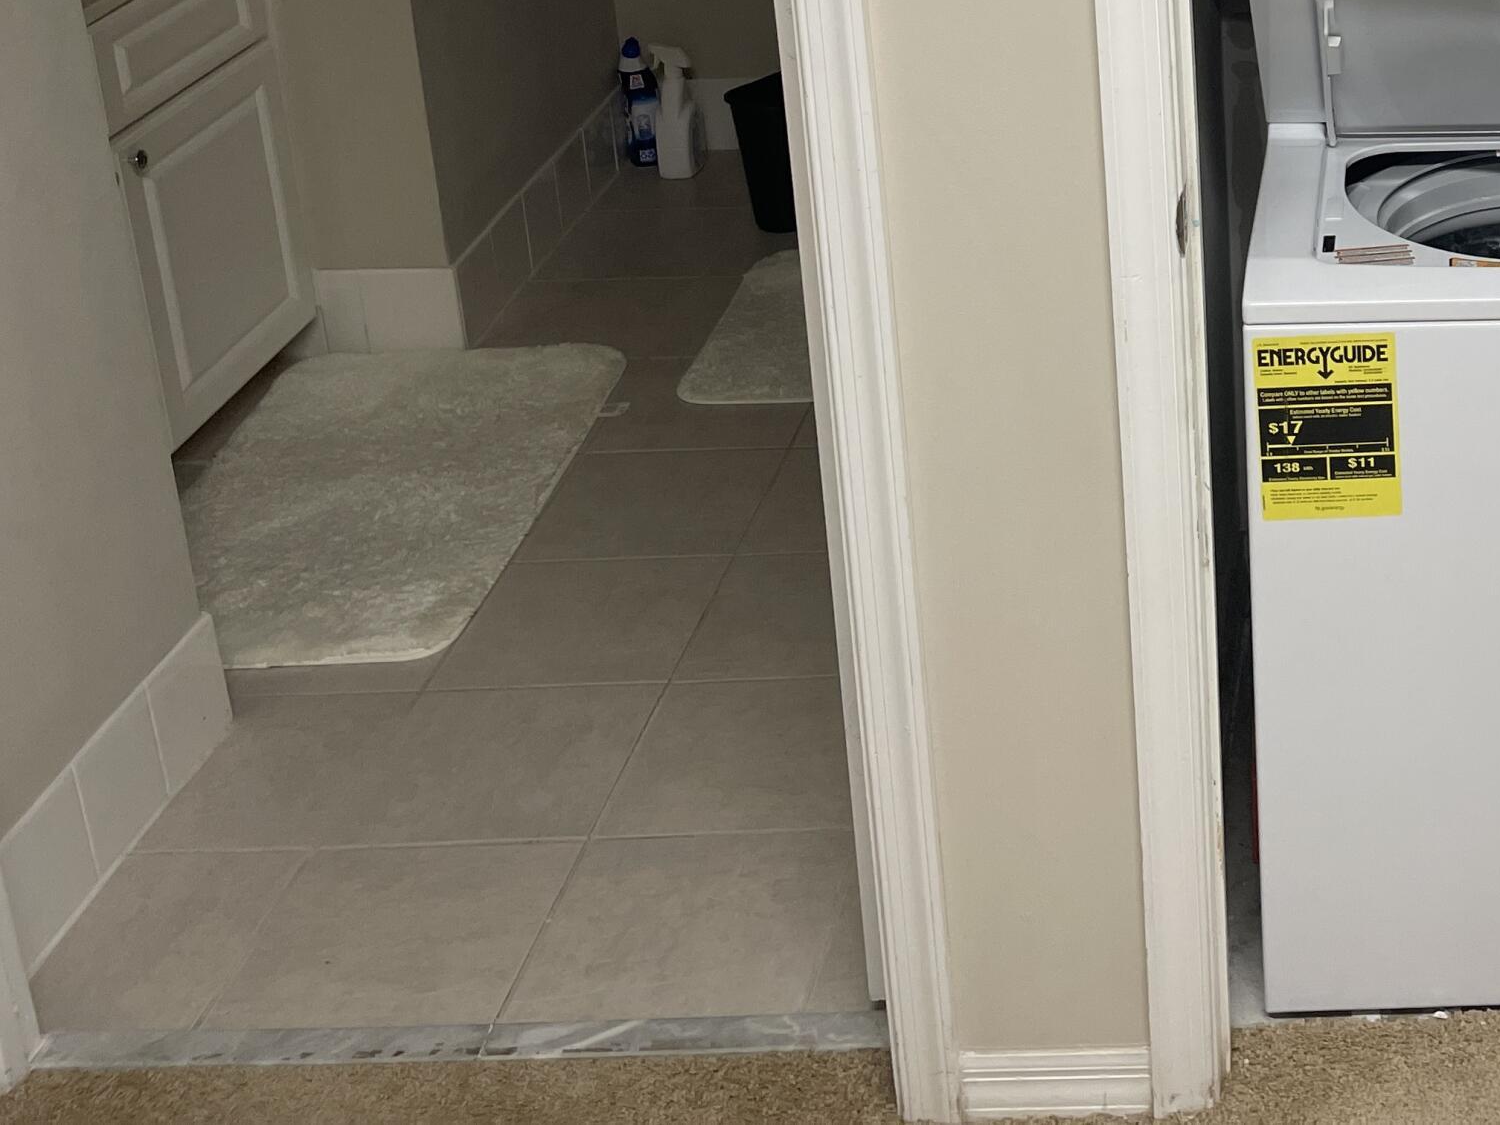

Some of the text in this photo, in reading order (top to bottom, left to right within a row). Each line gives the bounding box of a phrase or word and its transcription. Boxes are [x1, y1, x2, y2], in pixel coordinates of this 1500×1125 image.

[1257, 344, 1389, 368] ENERGYGUIDE
[1268, 420, 1303, 435] $17
[1274, 462, 1300, 473] 138
[1347, 457, 1375, 469] $11
